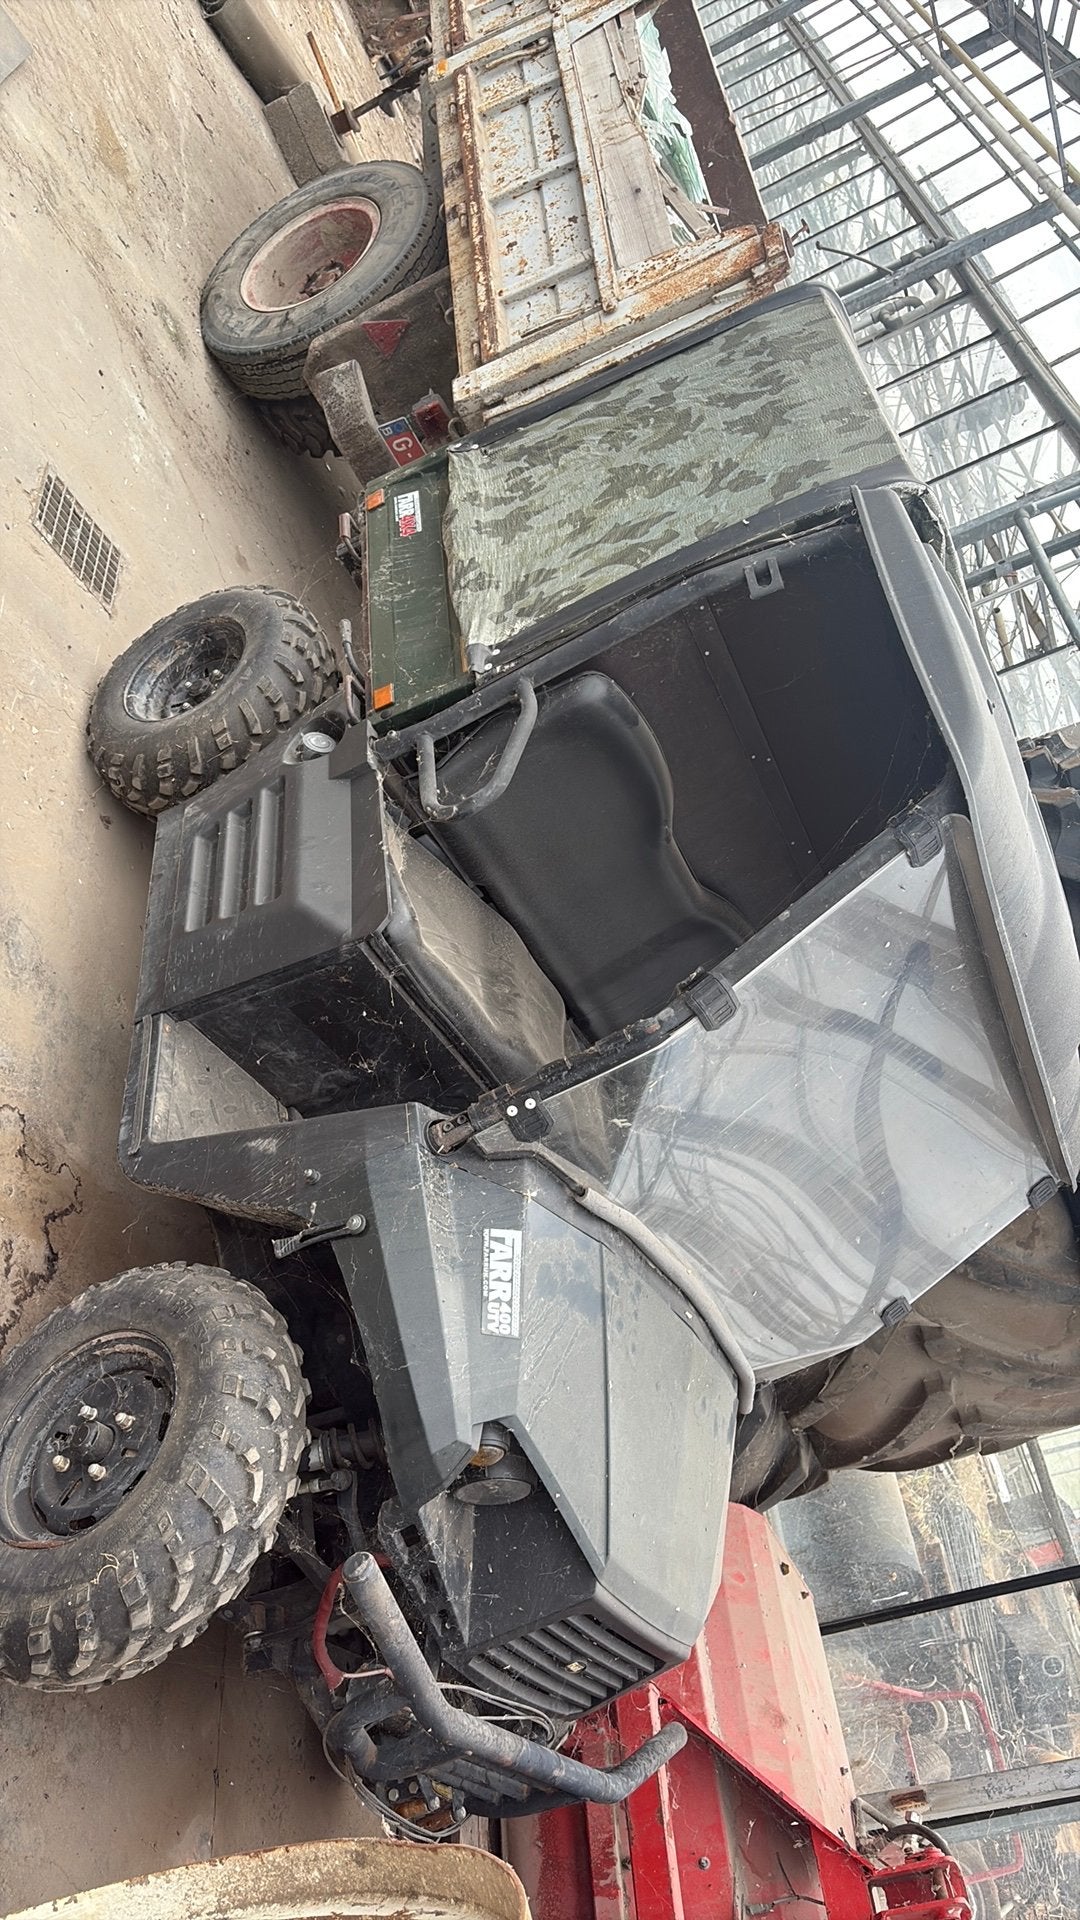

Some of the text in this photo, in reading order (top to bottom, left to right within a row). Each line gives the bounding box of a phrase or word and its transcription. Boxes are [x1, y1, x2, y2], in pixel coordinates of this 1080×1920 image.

[382, 426, 393, 437] B
[488, 1228, 522, 1335] FARR 400
[487, 1301, 500, 1335] UTV
